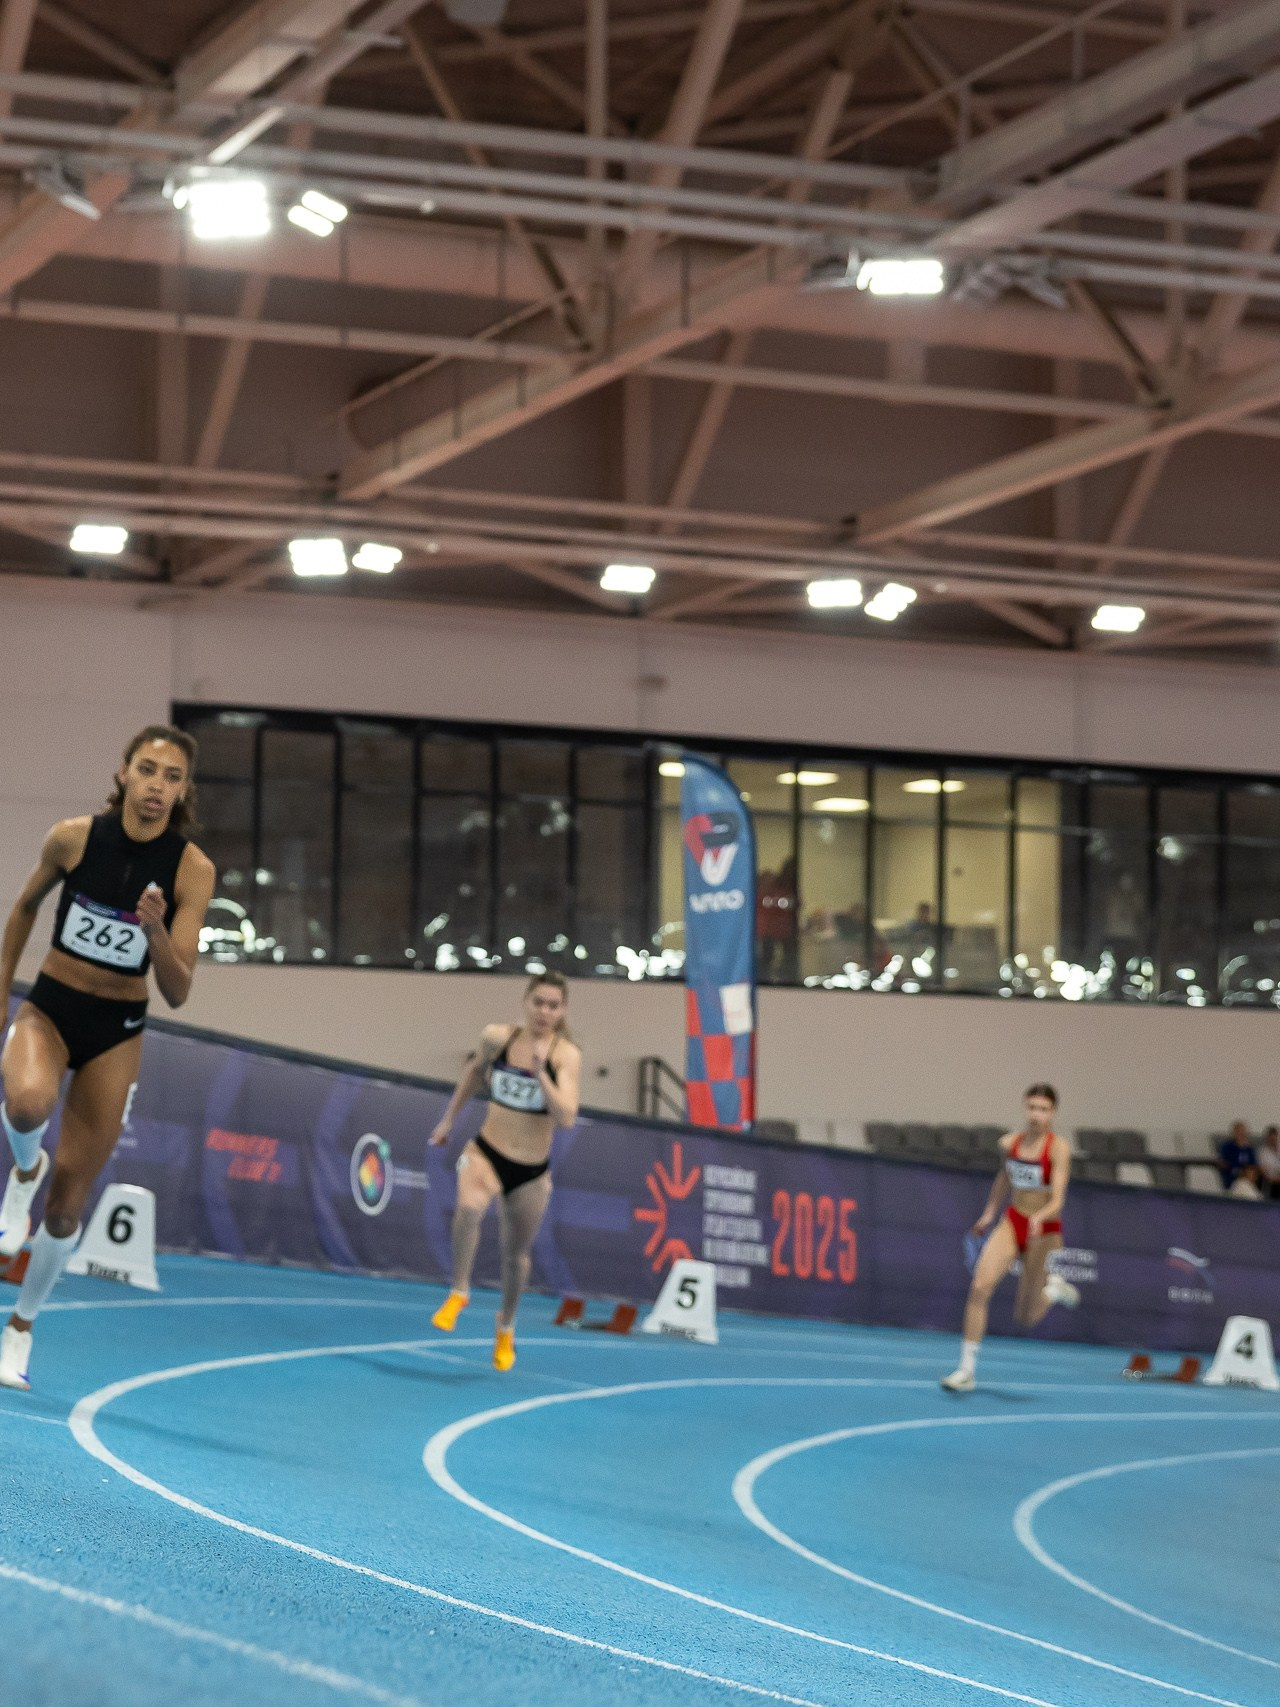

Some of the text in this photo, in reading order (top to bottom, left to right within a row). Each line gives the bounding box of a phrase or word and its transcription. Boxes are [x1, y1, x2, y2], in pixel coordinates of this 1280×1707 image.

[76, 917, 130, 953] 262
[107, 1204, 136, 1244] 6
[771, 1189, 858, 1284] 2025
[676, 1276, 700, 1309] 5
[1234, 1331, 1254, 1360] 4
